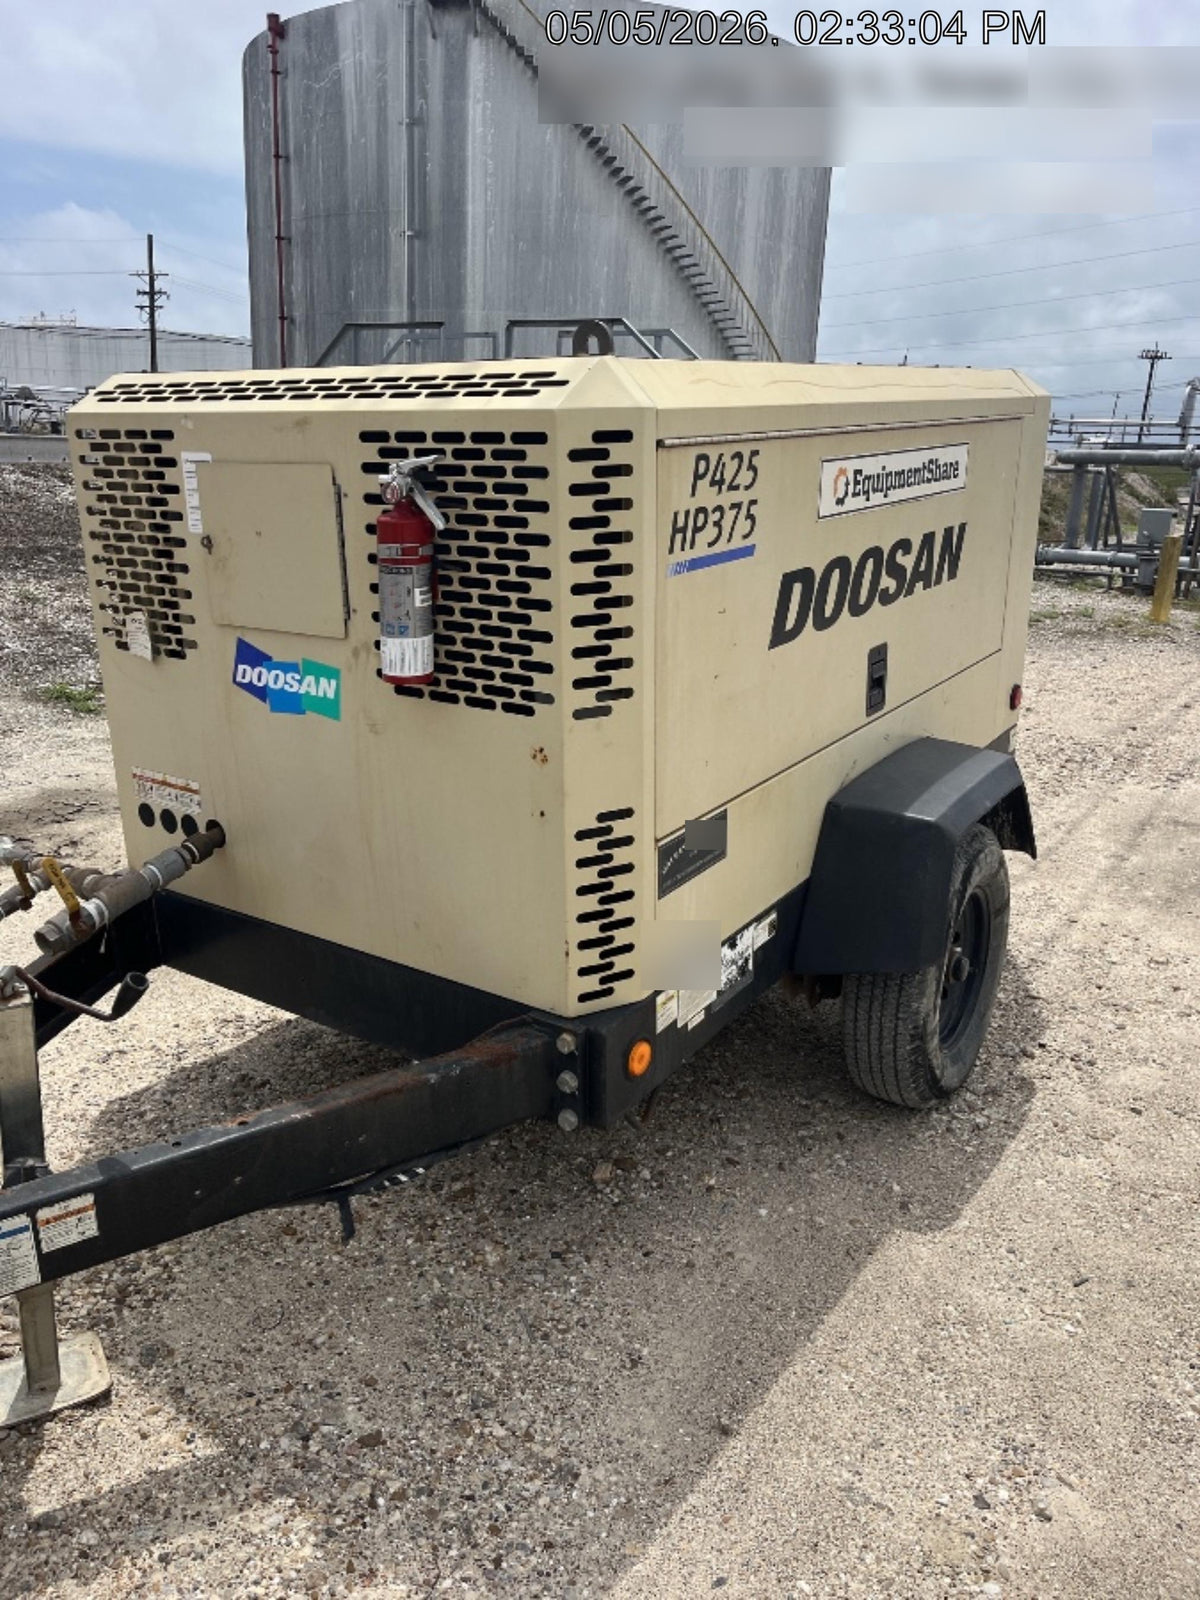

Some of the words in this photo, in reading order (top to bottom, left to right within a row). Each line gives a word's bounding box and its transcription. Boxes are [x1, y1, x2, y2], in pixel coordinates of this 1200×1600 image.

[690, 449, 760, 498] P425
[851, 458, 959, 501] EquipmentShare
[668, 499, 758, 555] HP375
[768, 522, 967, 651] DOOSAN
[235, 664, 337, 699] DOOSAN
